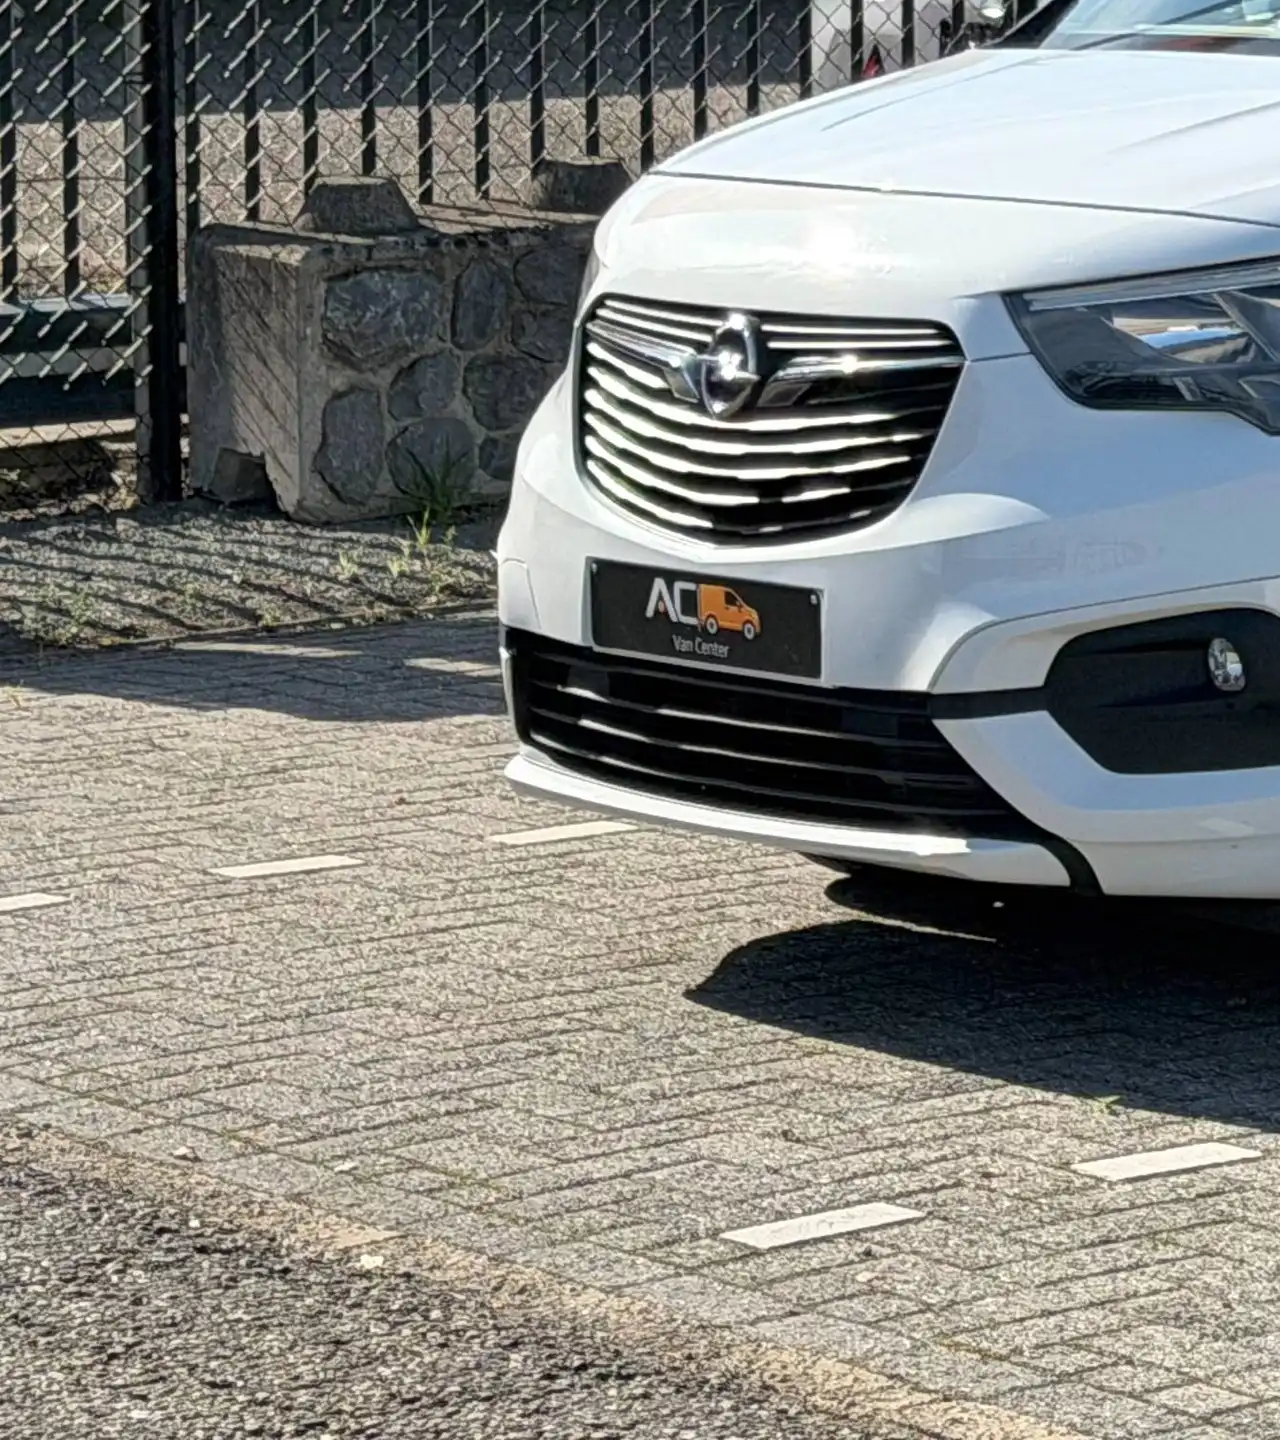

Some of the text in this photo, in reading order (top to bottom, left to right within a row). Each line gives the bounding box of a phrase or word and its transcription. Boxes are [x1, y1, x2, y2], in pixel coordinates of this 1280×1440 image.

[645, 577, 699, 626] AC
[672, 634, 730, 658] Van Center
